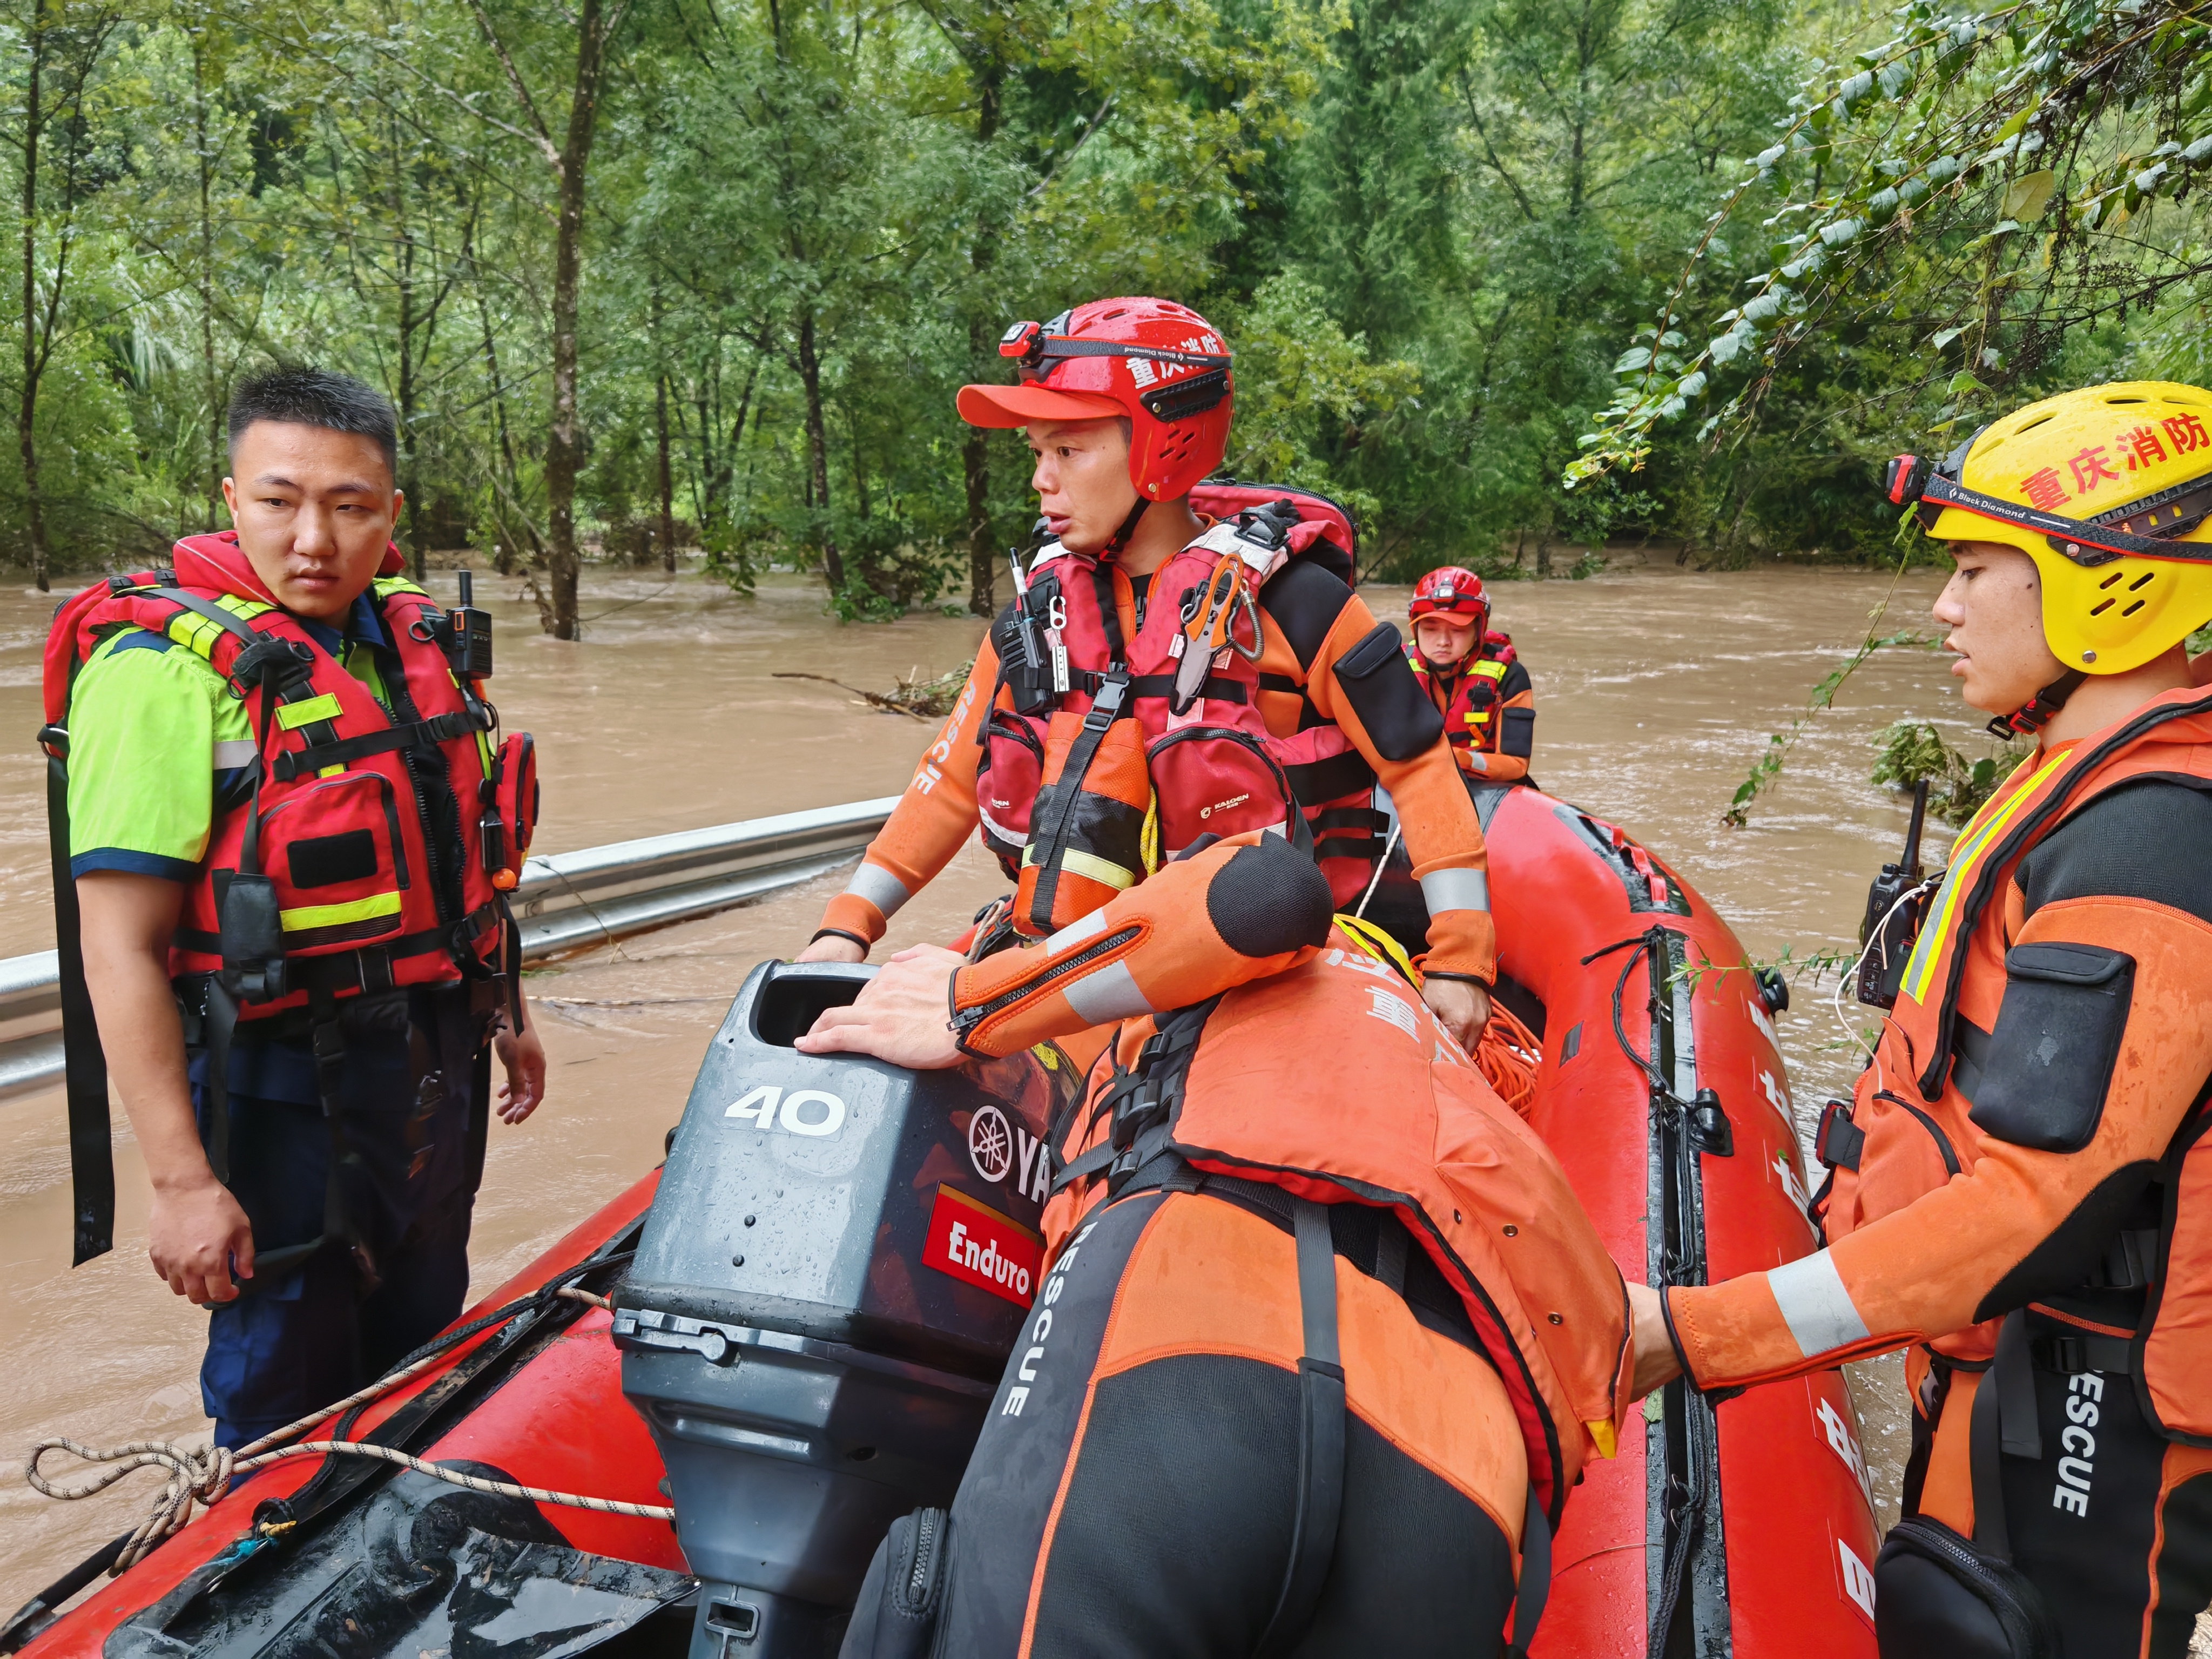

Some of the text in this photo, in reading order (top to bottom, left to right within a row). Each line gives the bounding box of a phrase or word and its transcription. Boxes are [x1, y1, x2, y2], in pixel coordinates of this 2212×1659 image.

[1124, 347, 1176, 359] Black Diamond
[1958, 492, 2026, 519] Black Diamond
[2019, 412, 2211, 512] 重庆消防
[912, 679, 976, 795] RESCUE
[724, 1085, 846, 1137] 40
[948, 1220, 1029, 1295] Enduro
[1001, 1221, 1098, 1417] RESCUE
[2053, 1368, 2105, 1518] ESCUE
